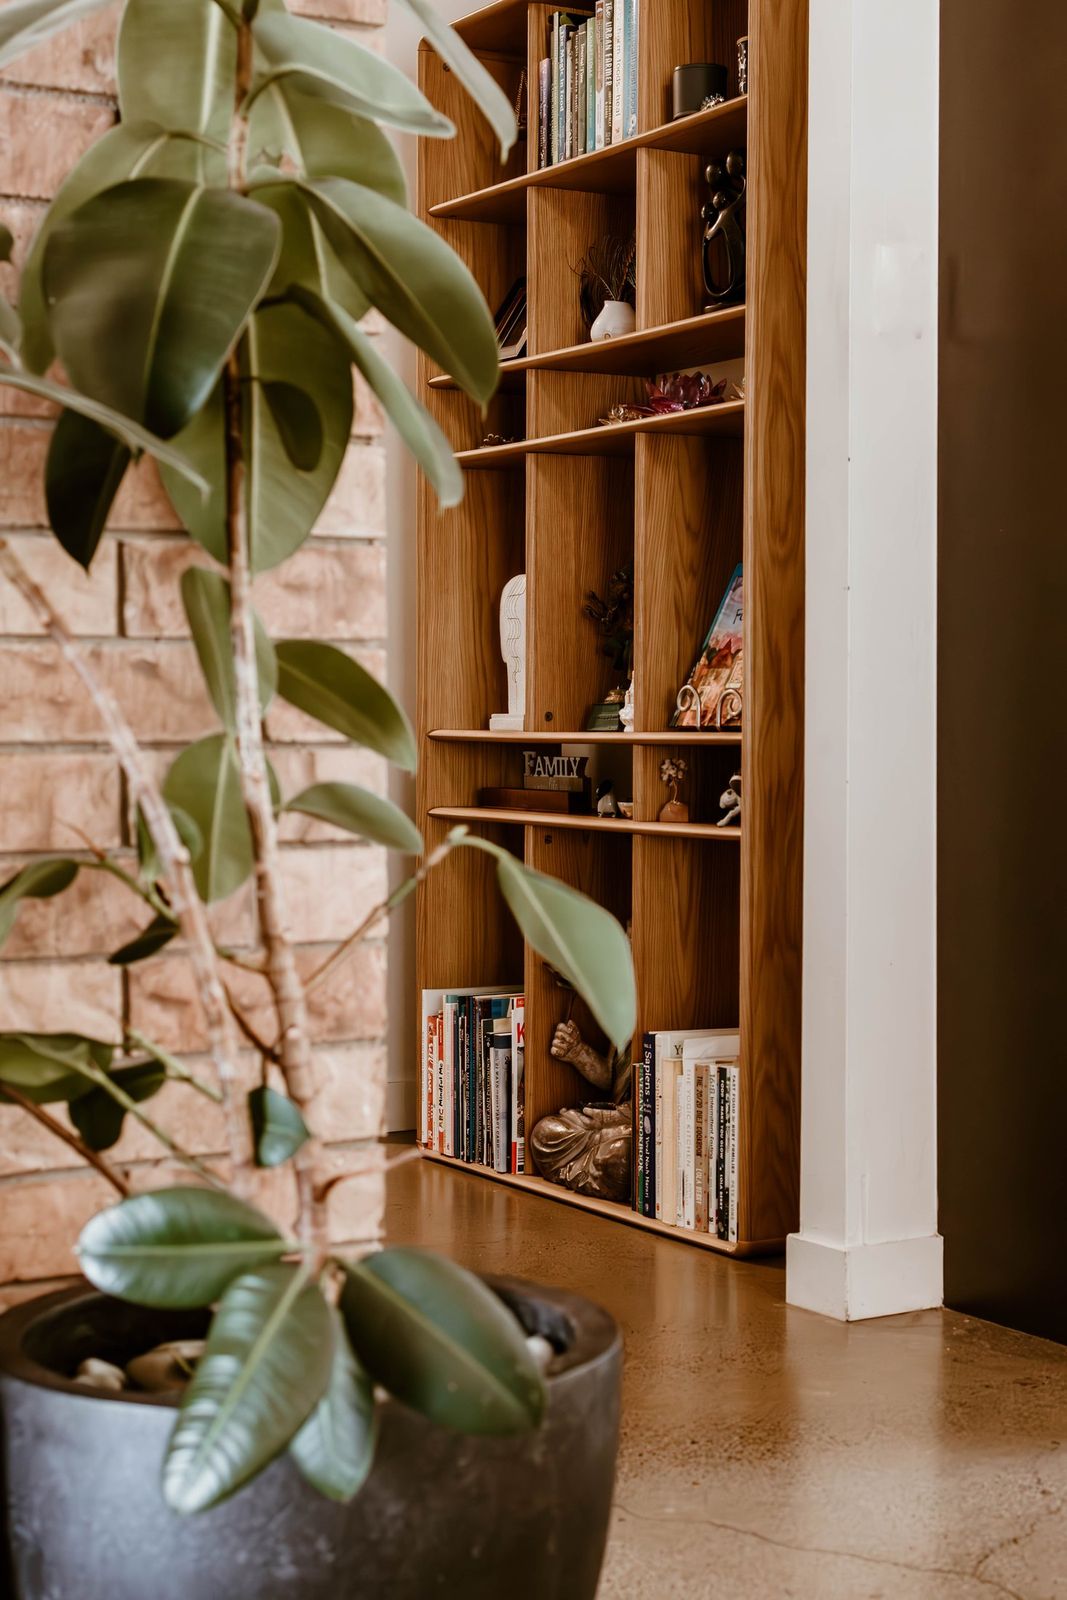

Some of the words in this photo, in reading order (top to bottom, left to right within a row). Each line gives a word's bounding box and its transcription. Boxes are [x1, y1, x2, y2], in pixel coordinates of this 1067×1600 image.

[604, 2, 613, 18] The
[604, 21, 613, 51] URBAN
[604, 53, 613, 87] FARMER
[523, 751, 581, 778] FAMILY
[438, 1062, 444, 1076] Me
[643, 1051, 652, 1096] Sapiens
[696, 1076, 704, 1087] THE
[696, 1089, 704, 1108] 20/20
[696, 1109, 704, 1124] DIET
